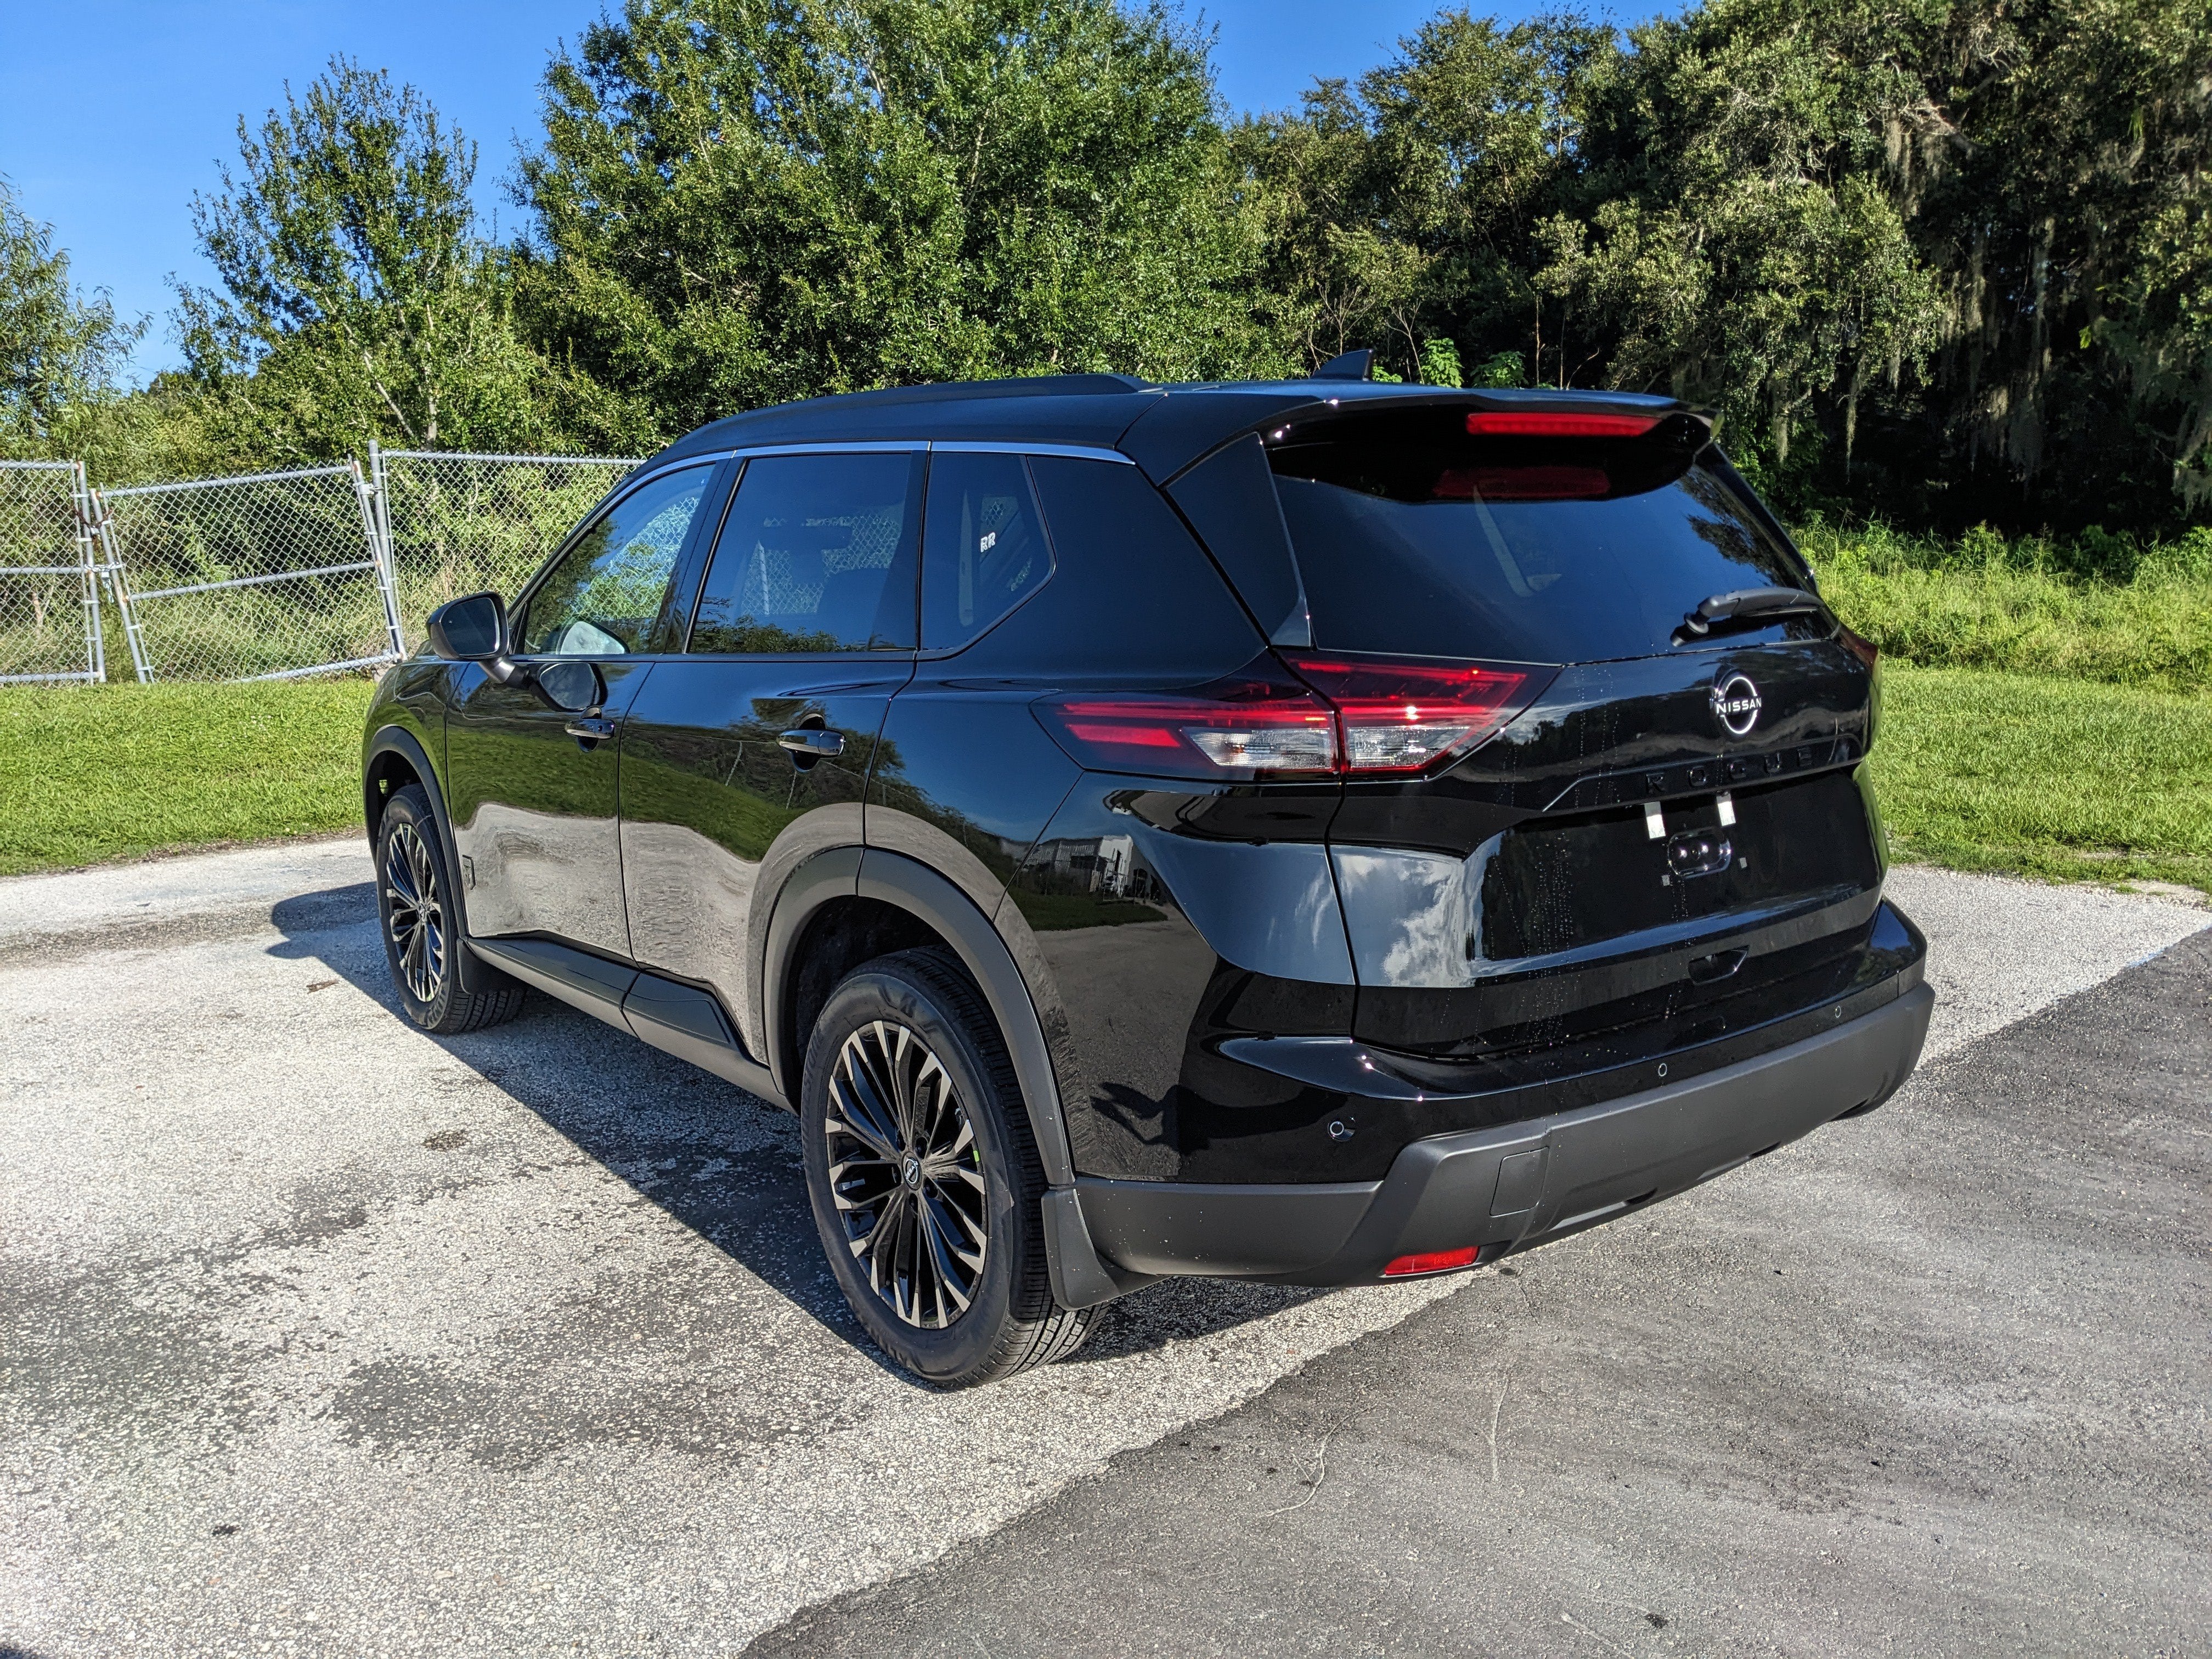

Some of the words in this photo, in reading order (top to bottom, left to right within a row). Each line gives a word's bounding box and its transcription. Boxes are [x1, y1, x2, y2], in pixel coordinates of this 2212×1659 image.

[980, 532, 996, 552] RR
[1716, 697, 1762, 714] NISSAN
[1645, 747, 1813, 794] ROGUE
